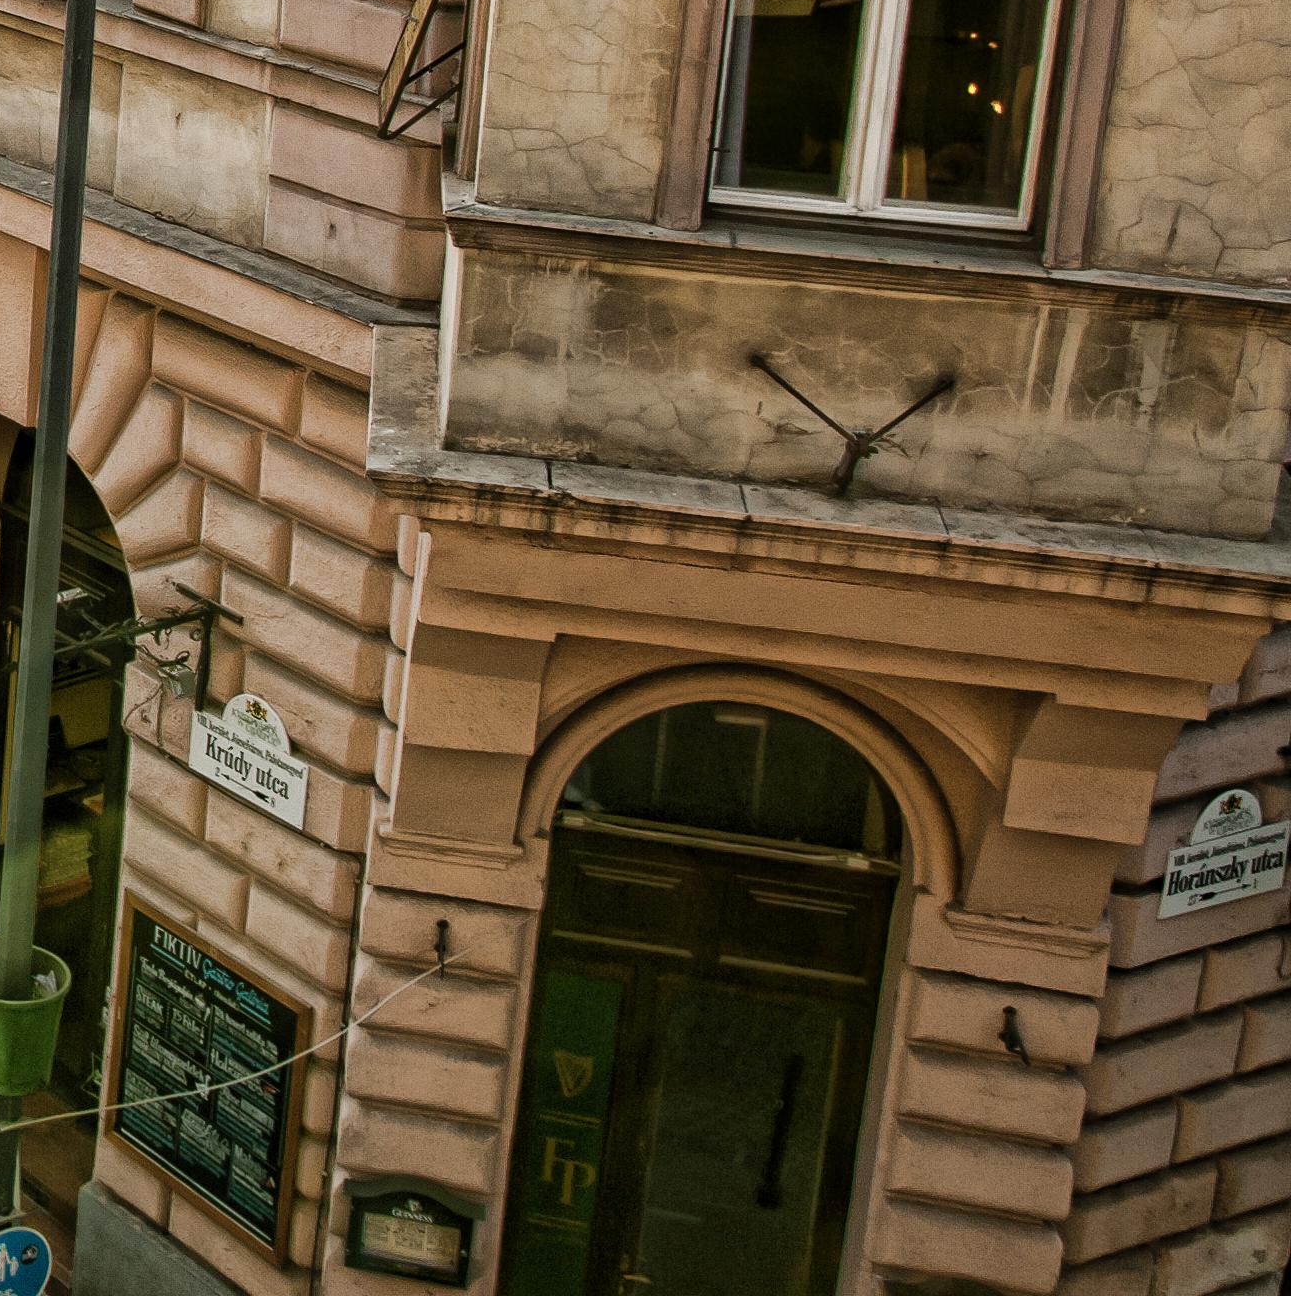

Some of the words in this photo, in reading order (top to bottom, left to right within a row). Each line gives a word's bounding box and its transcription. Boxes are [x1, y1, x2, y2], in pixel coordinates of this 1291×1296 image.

[206, 733, 252, 781] Krúdy
[256, 767, 289, 800] utca
[1167, 855, 1248, 896] Horánszky
[1251, 849, 1283, 875] utca
